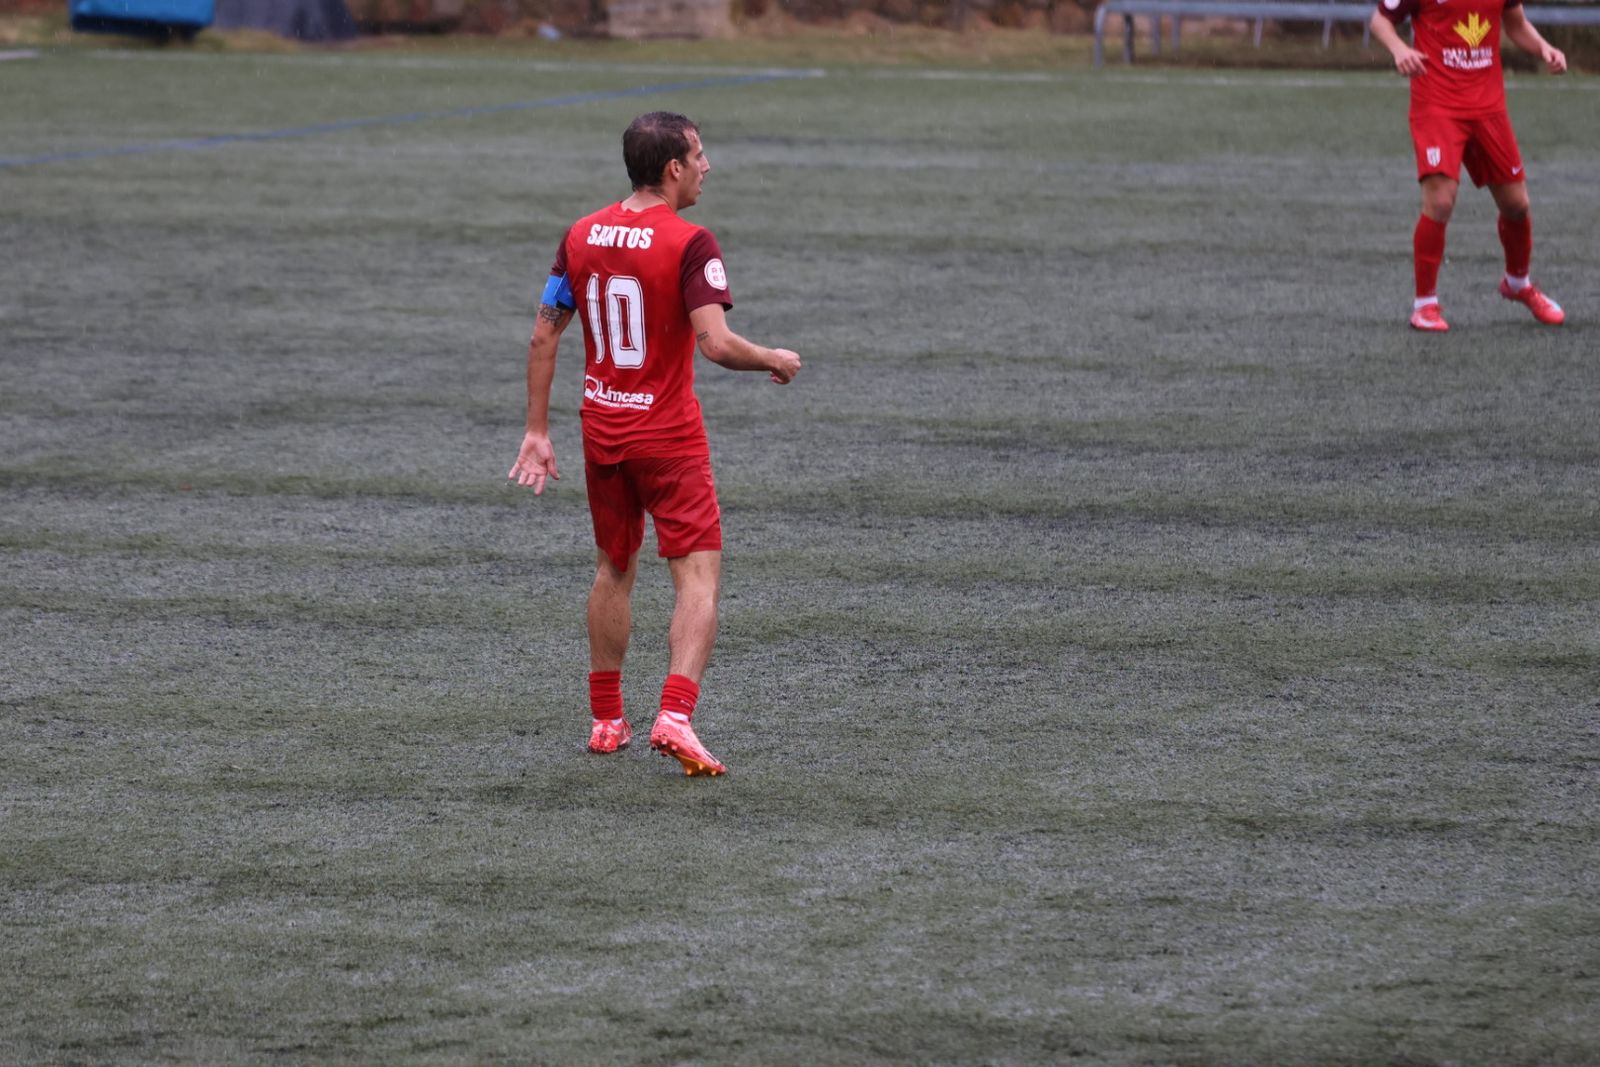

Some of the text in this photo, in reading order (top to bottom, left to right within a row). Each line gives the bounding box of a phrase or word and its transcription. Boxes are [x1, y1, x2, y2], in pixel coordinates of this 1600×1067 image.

[587, 223, 654, 249] SANTOS
[586, 273, 647, 369] 10
[597, 381, 654, 405] Limcasa
